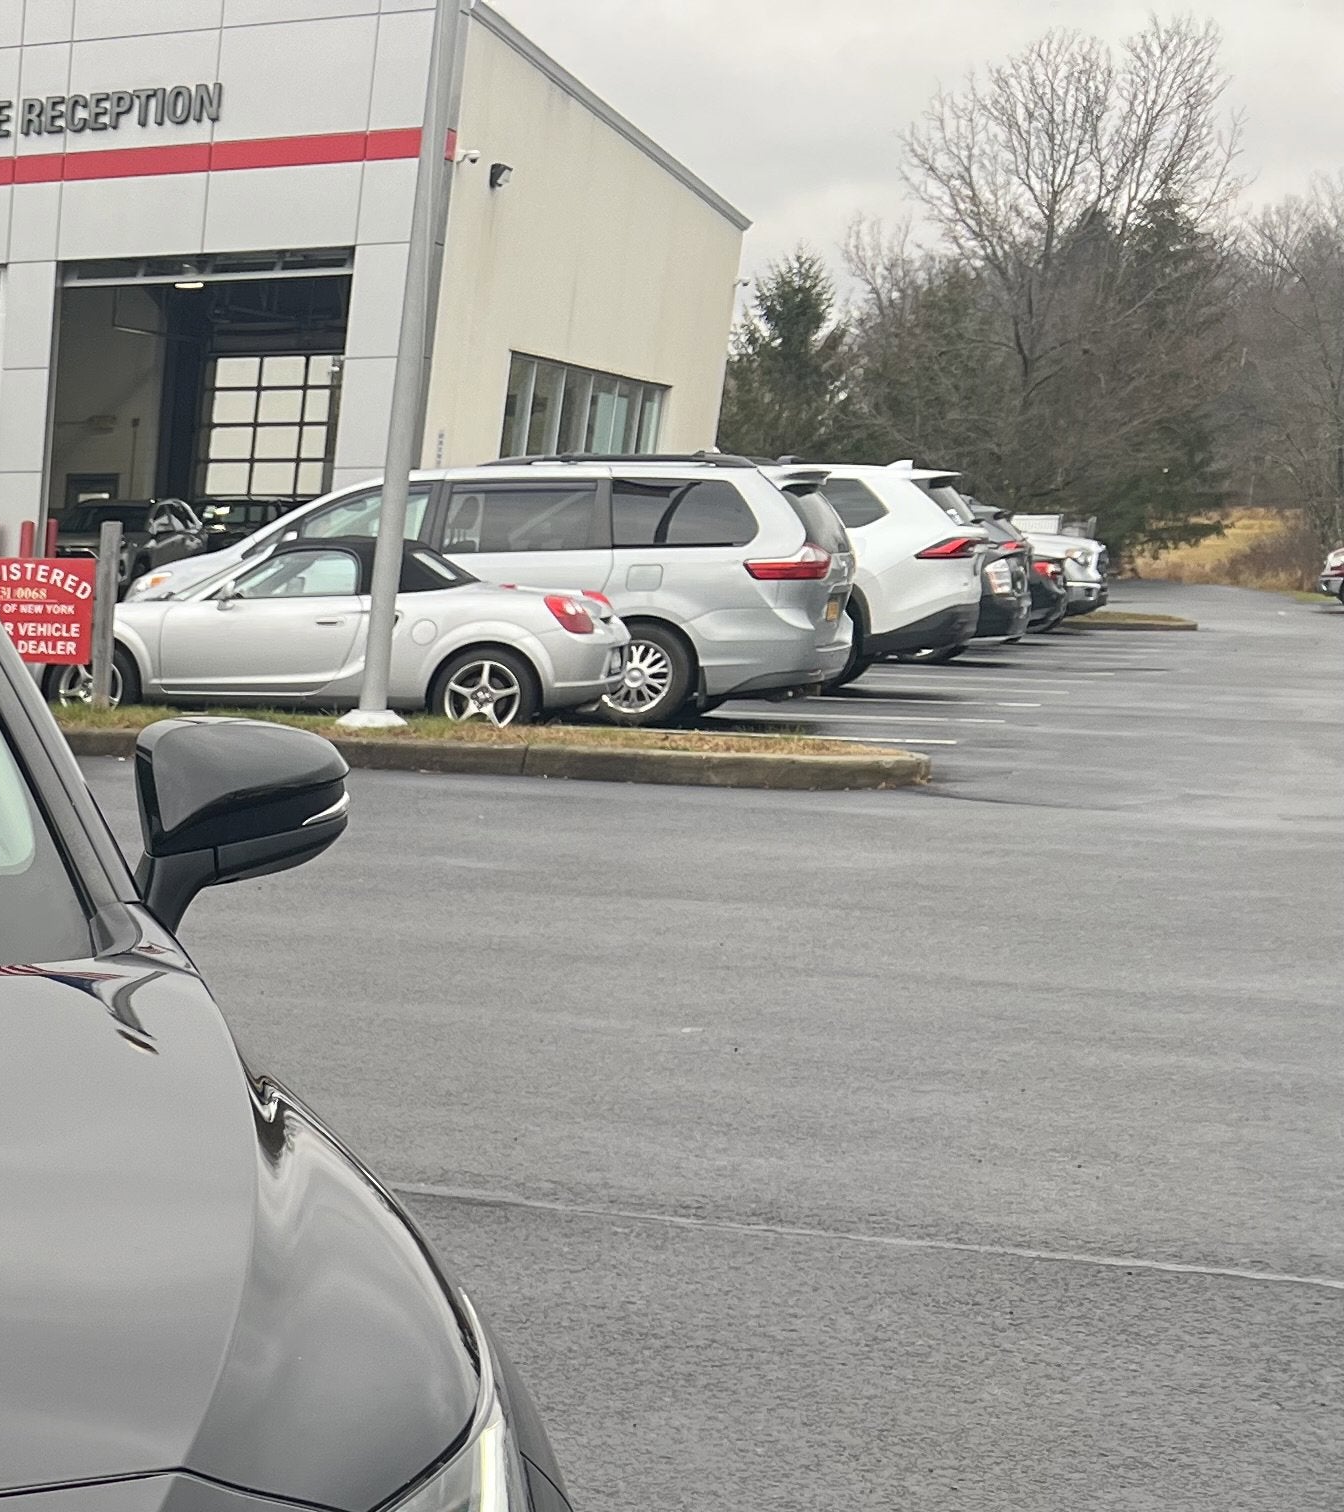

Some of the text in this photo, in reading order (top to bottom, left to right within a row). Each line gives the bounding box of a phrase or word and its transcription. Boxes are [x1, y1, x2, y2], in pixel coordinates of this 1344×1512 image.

[20, 82, 223, 136] RECEPTION
[3, 603, 17, 613] OF
[19, 604, 44, 614] NEW
[45, 604, 75, 615] YORK
[17, 622, 81, 638] VEHICLE
[17, 640, 77, 655] DEALER
